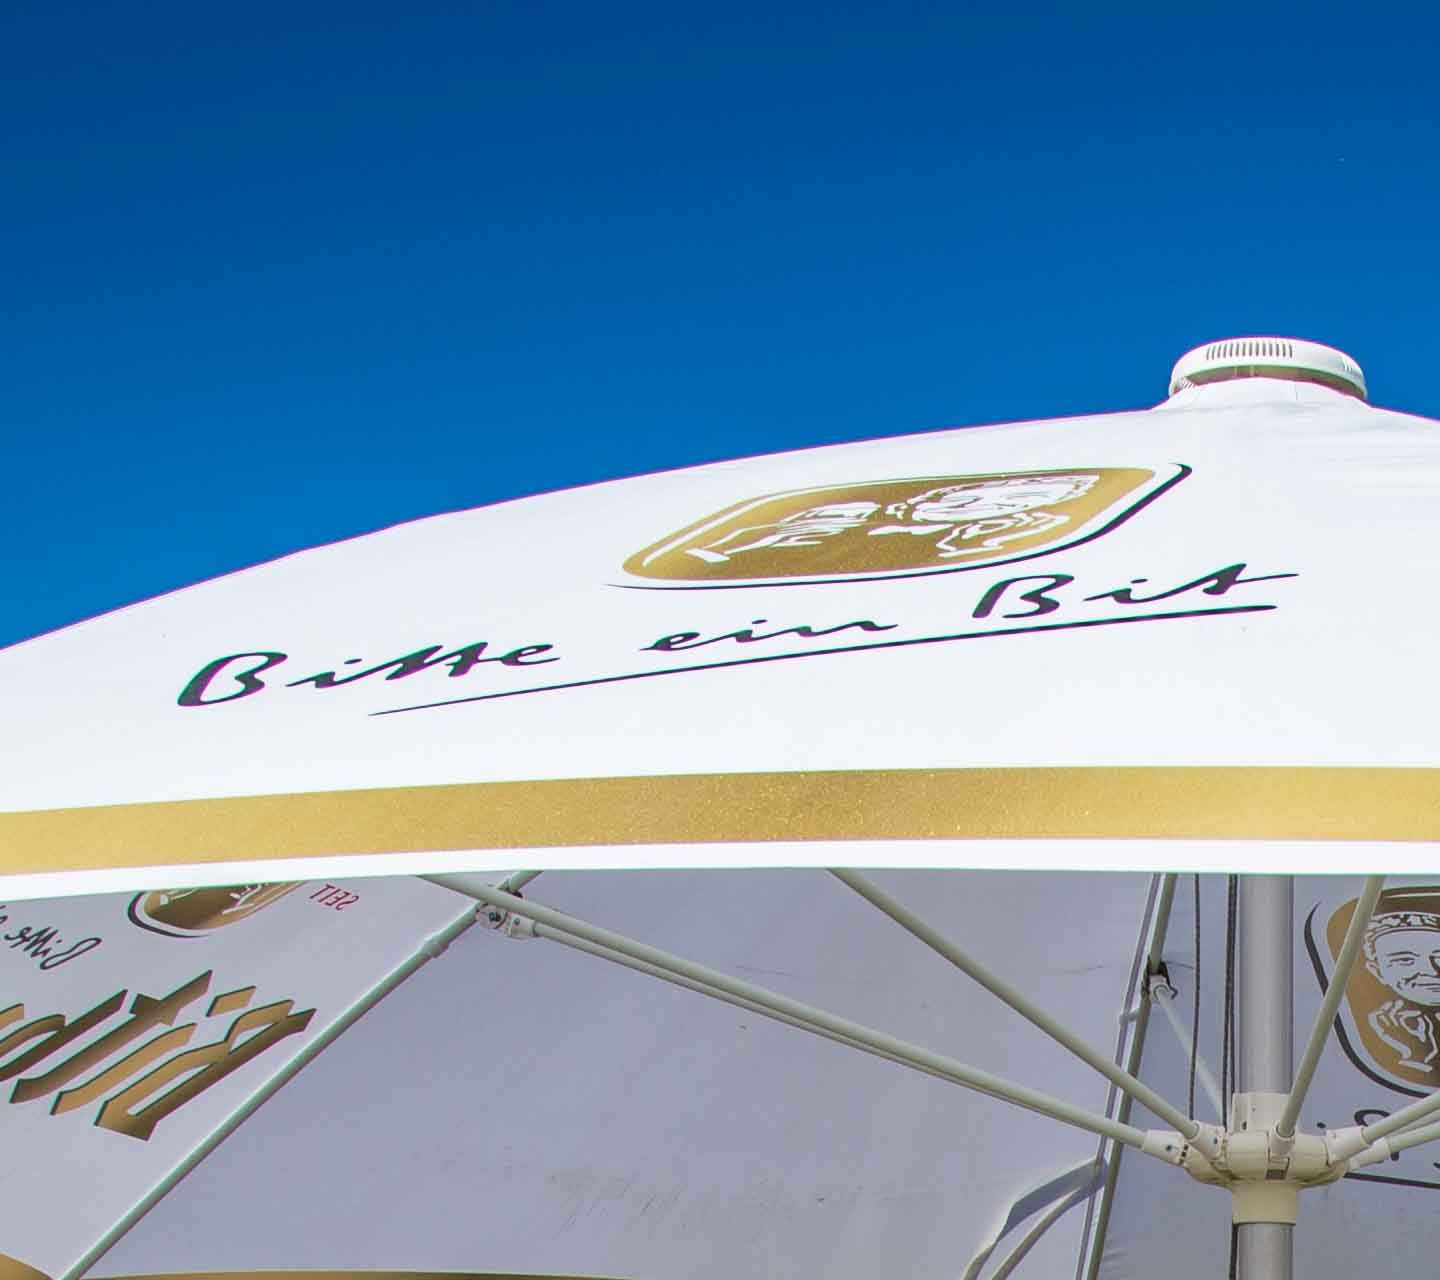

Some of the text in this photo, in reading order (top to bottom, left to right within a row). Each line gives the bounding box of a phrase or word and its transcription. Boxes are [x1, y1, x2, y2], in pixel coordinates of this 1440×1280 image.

[175, 561, 1301, 709] Bitte ein Bit
